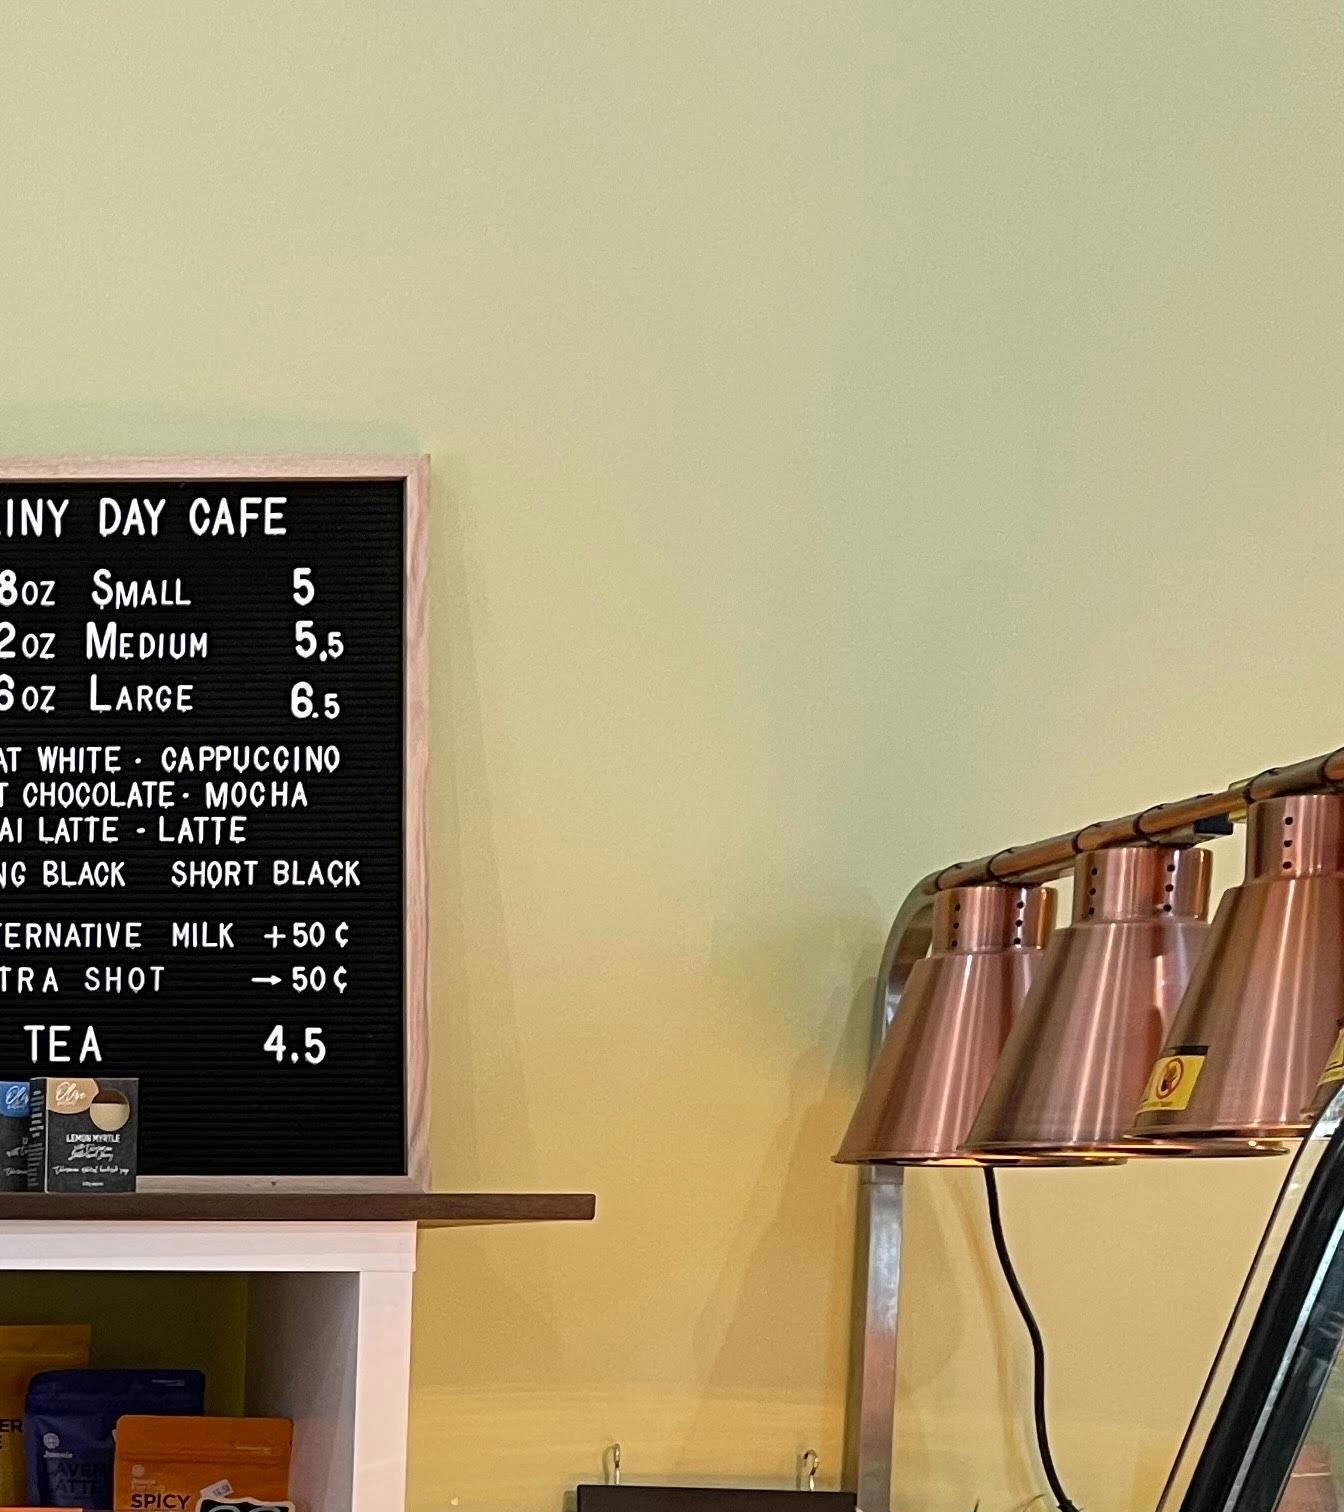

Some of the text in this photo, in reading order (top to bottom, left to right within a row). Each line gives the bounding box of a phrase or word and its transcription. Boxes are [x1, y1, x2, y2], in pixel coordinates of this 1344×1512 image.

[100, 498, 166, 537] DAY
[190, 497, 287, 536] CAFE
[293, 568, 314, 605] 5
[291, 682, 340, 718] 6.5
[38, 747, 120, 773] WHITE
[162, 746, 340, 772] CAPPUCCINO
[23, 781, 175, 810] CHOCOLATE
[206, 782, 307, 808] MOCHA
[39, 817, 118, 844] LATTE
[159, 816, 246, 844] LATTE
[43, 861, 125, 888] BLACK
[171, 860, 259, 888] SHORT
[273, 861, 360, 888] BLACK
[172, 923, 234, 948] MILK
[84, 966, 164, 993] SHOT
[24, 1024, 326, 1064] TEA 4.5
[131, 1494, 191, 1509] SPICY
